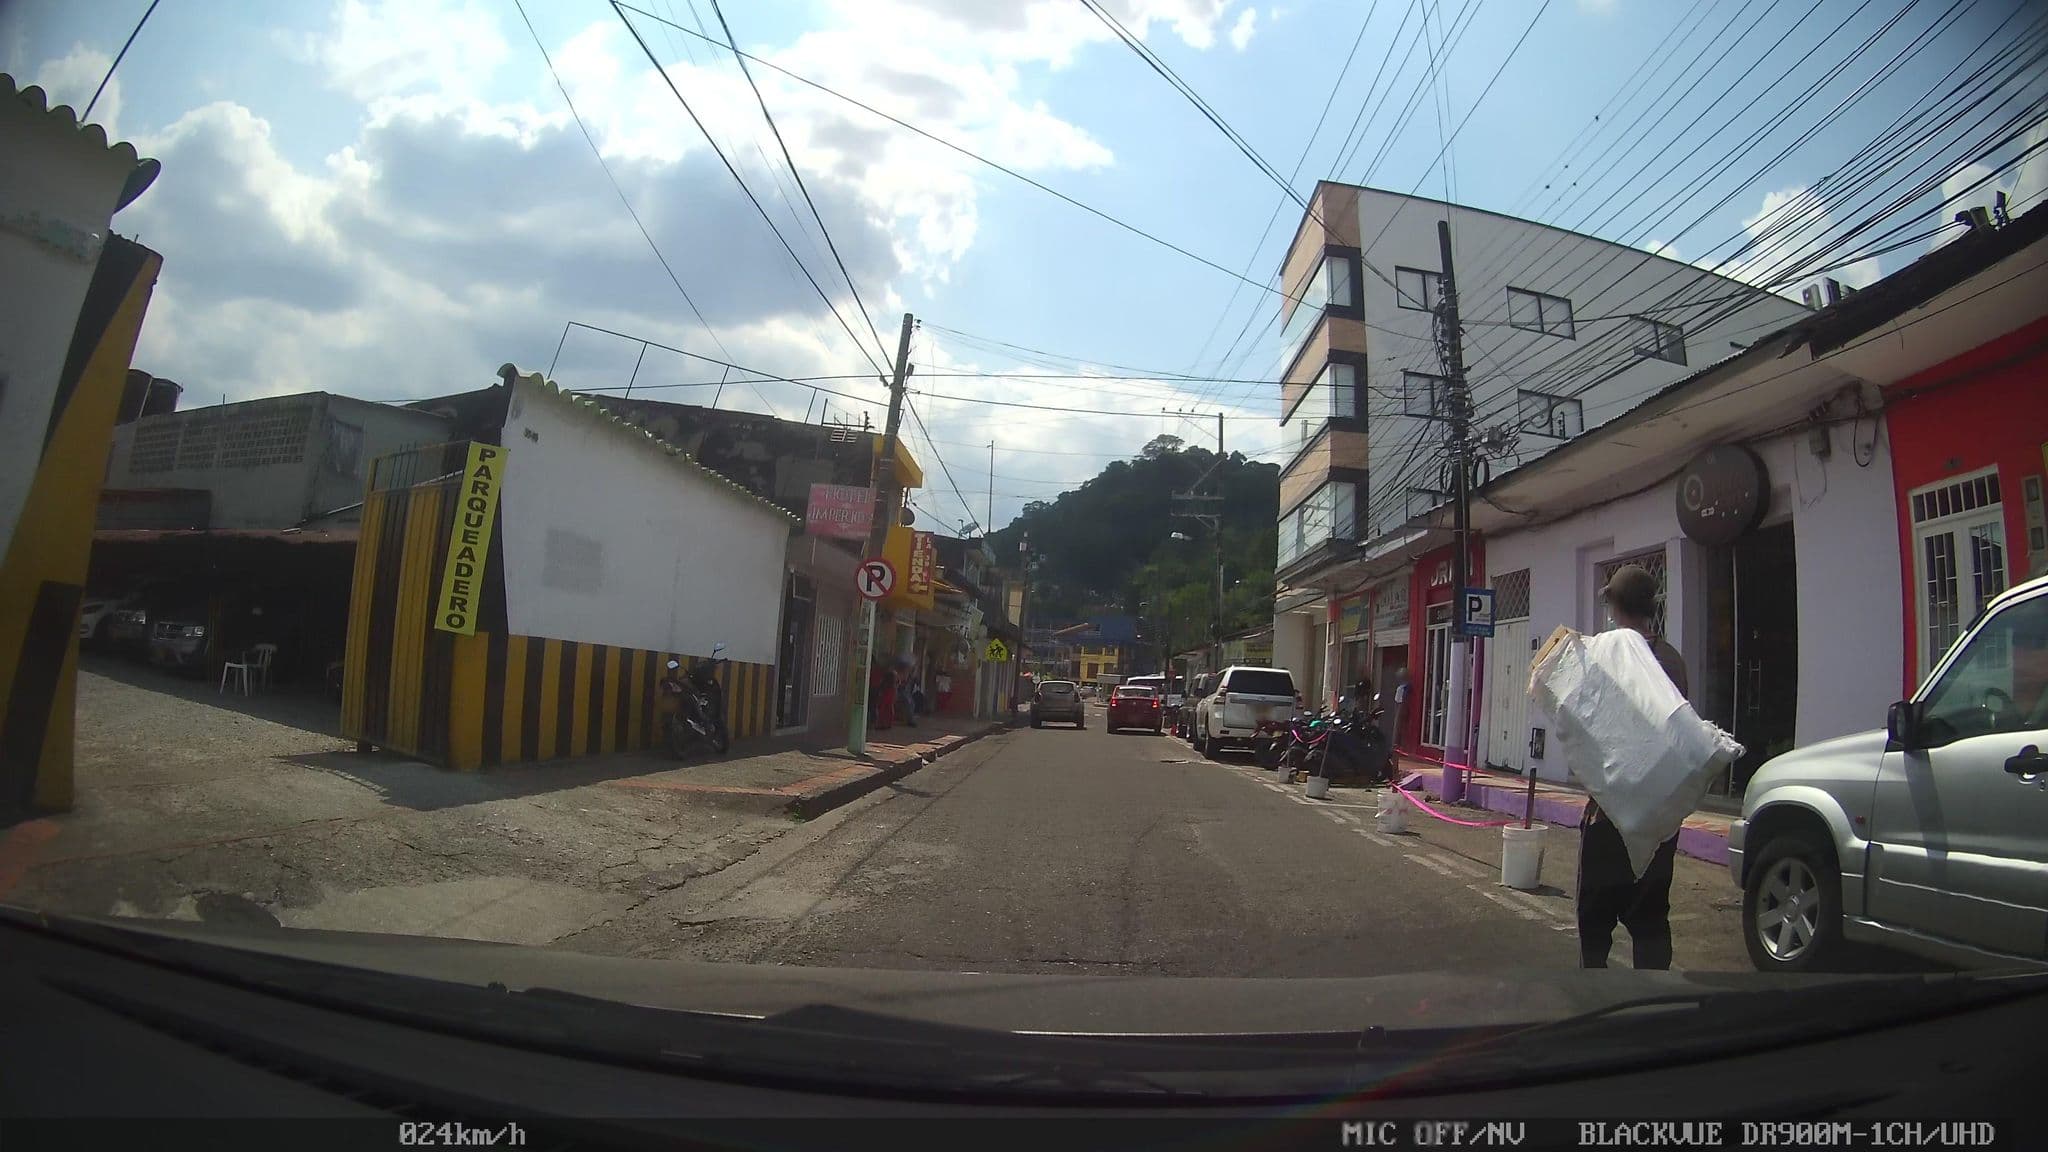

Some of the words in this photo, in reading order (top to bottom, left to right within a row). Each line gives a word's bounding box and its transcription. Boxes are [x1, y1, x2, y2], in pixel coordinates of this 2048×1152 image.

[446, 448, 496, 629] PARQUEADERO
[910, 533, 926, 583] TIENDA
[866, 564, 886, 592] P
[1468, 596, 1483, 622] P
